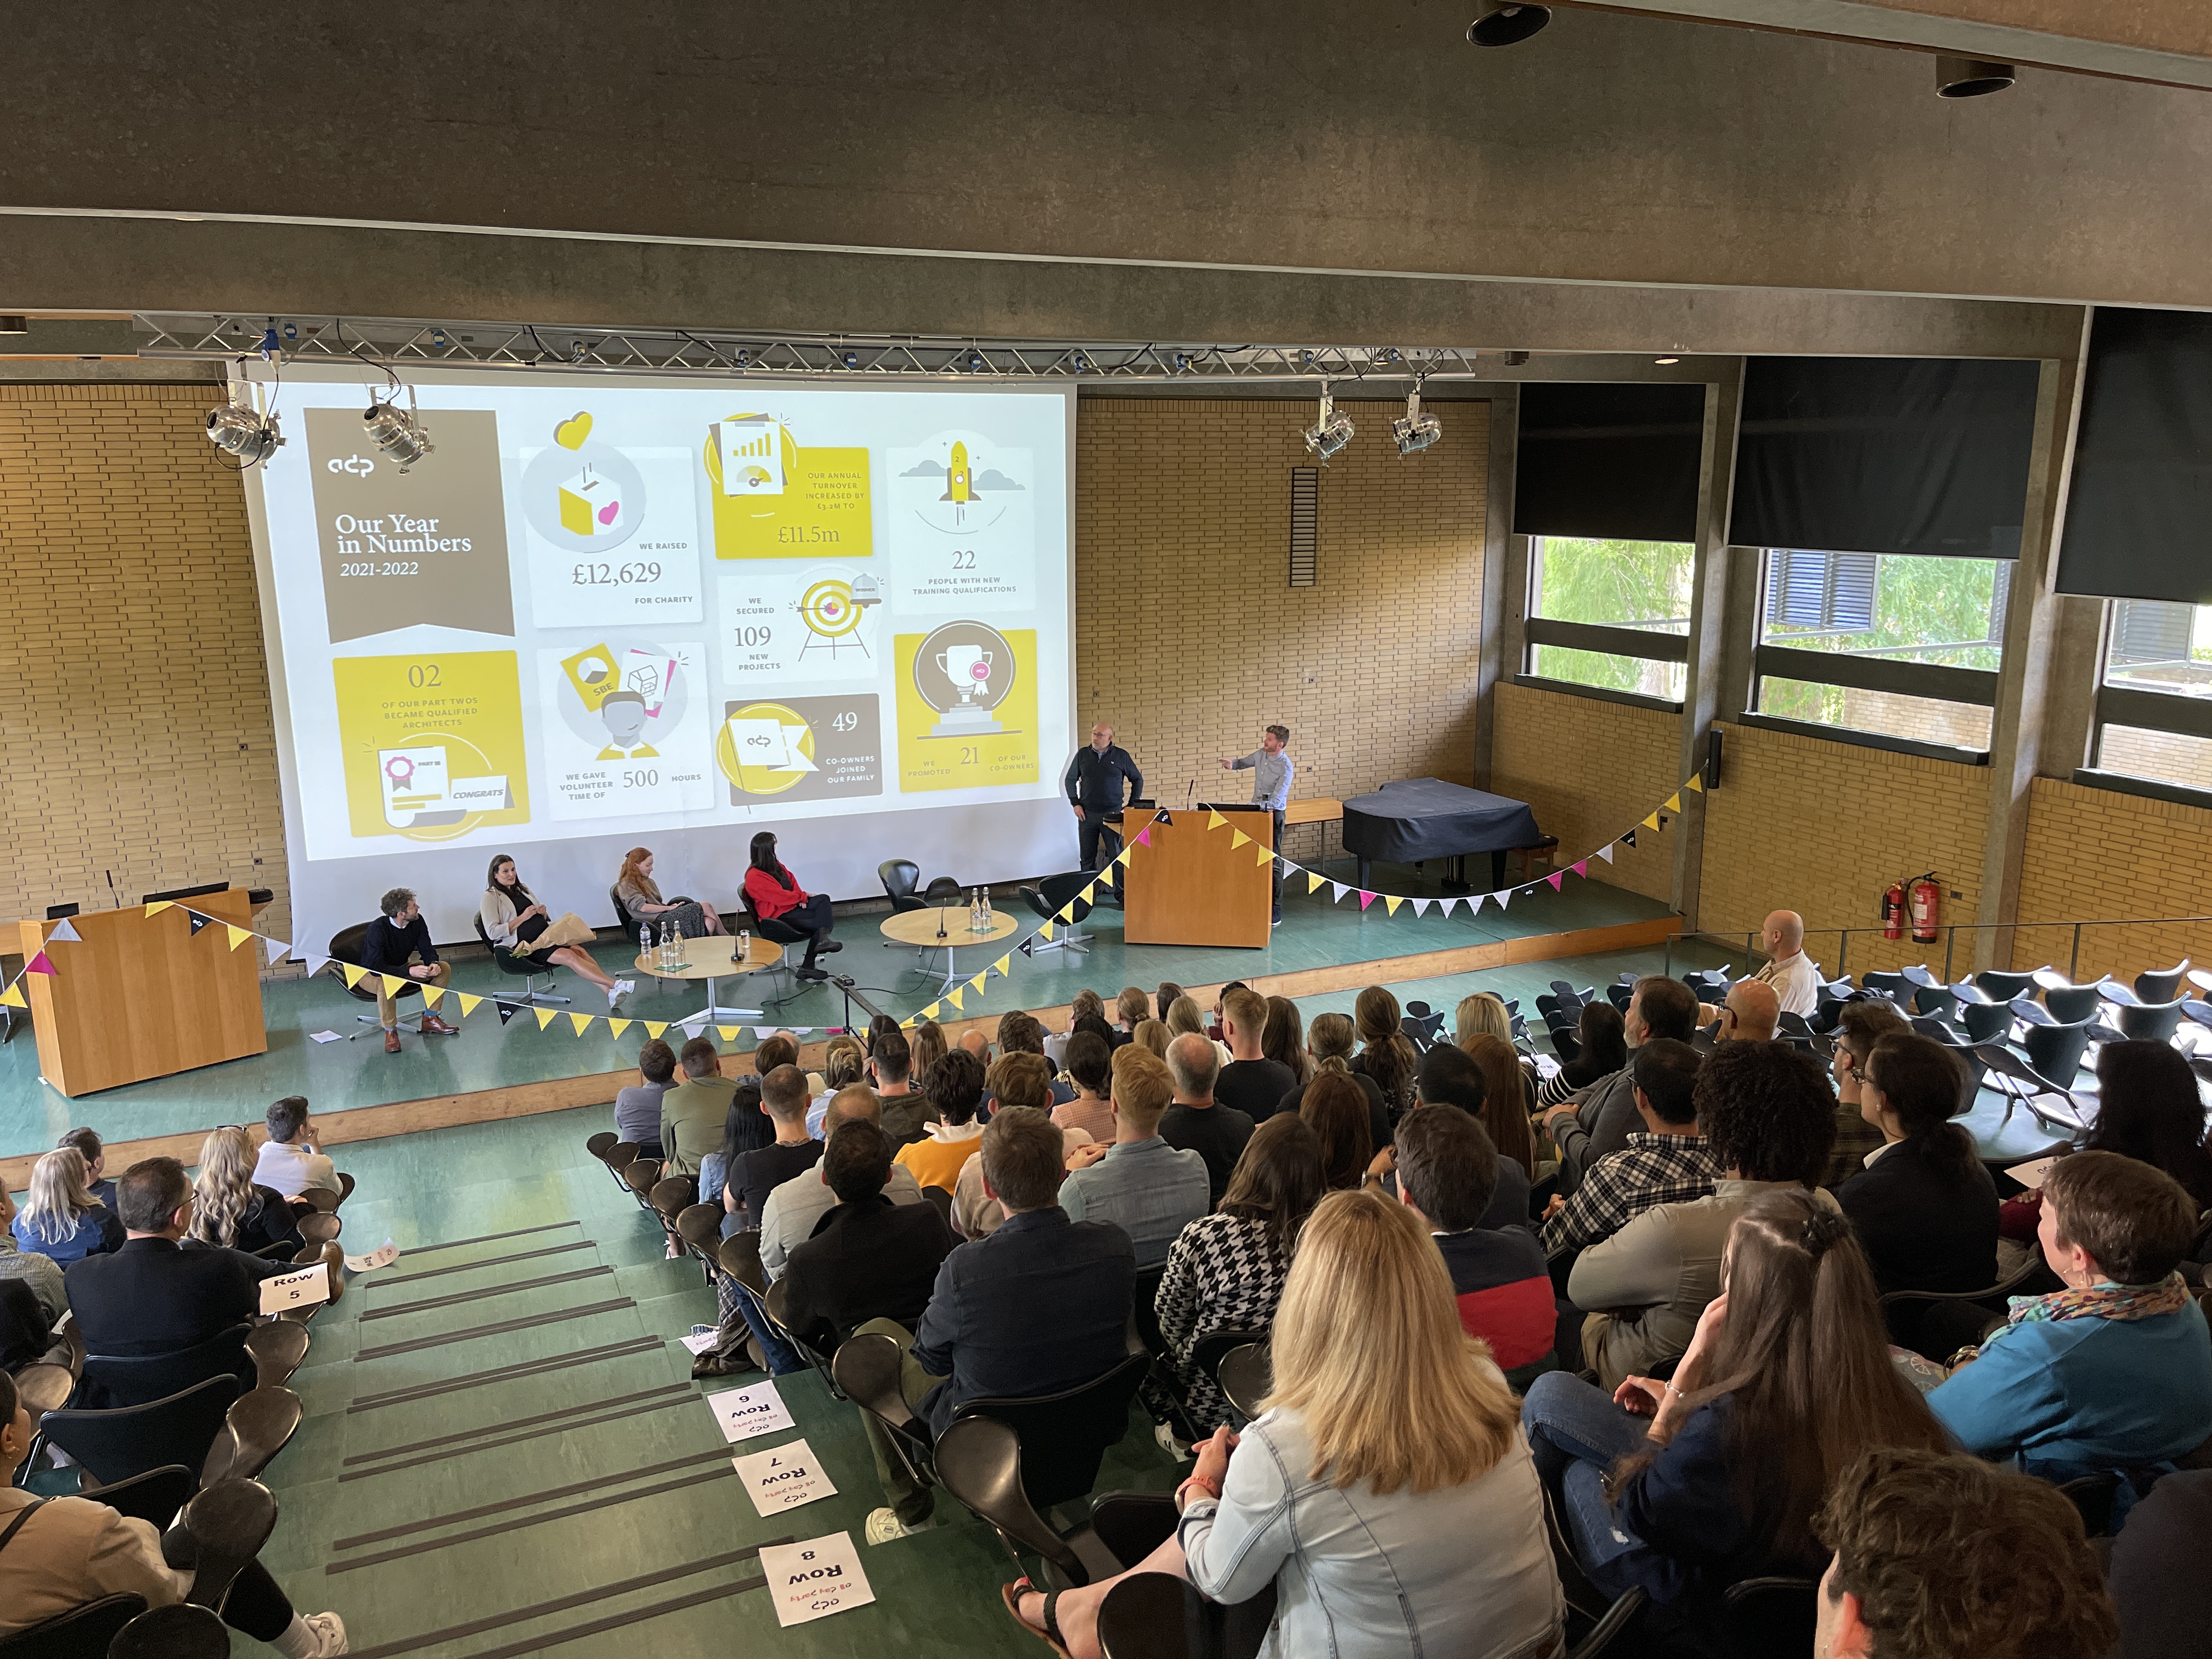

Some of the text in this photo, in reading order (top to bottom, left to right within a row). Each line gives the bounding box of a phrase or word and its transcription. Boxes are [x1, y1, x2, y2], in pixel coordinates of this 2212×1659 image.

[335, 514, 439, 533] Our Year
[778, 526, 840, 543] £11.5m
[337, 533, 472, 554] in Numbers
[952, 550, 977, 569] 22
[340, 562, 419, 577] 2021-2022
[572, 562, 662, 586] £12,629
[952, 586, 1017, 595] QUALIFICATIONS
[734, 626, 771, 647] 109
[408, 664, 442, 688] 02
[592, 682, 614, 697] SBE
[385, 708, 478, 719] BECAME QUALIFIED
[402, 719, 462, 729] ARCHITECTS
[832, 712, 857, 731] 49
[826, 755, 874, 765] CO-OWNERS
[960, 746, 980, 765] 21
[908, 769, 950, 777] PROMOTED
[990, 763, 1035, 771] CO-OWNERS
[560, 781, 613, 791] VOLUNTEER
[623, 769, 658, 788] 500
[453, 789, 504, 799] CONGRATS
[274, 1273, 314, 1286] Row
[290, 1290, 300, 1299] 5
[732, 1404, 770, 1418] Row
[771, 1458, 782, 1466] 7
[762, 1468, 806, 1486] Row
[801, 1551, 816, 1560] 8
[788, 1564, 843, 1585] Row
